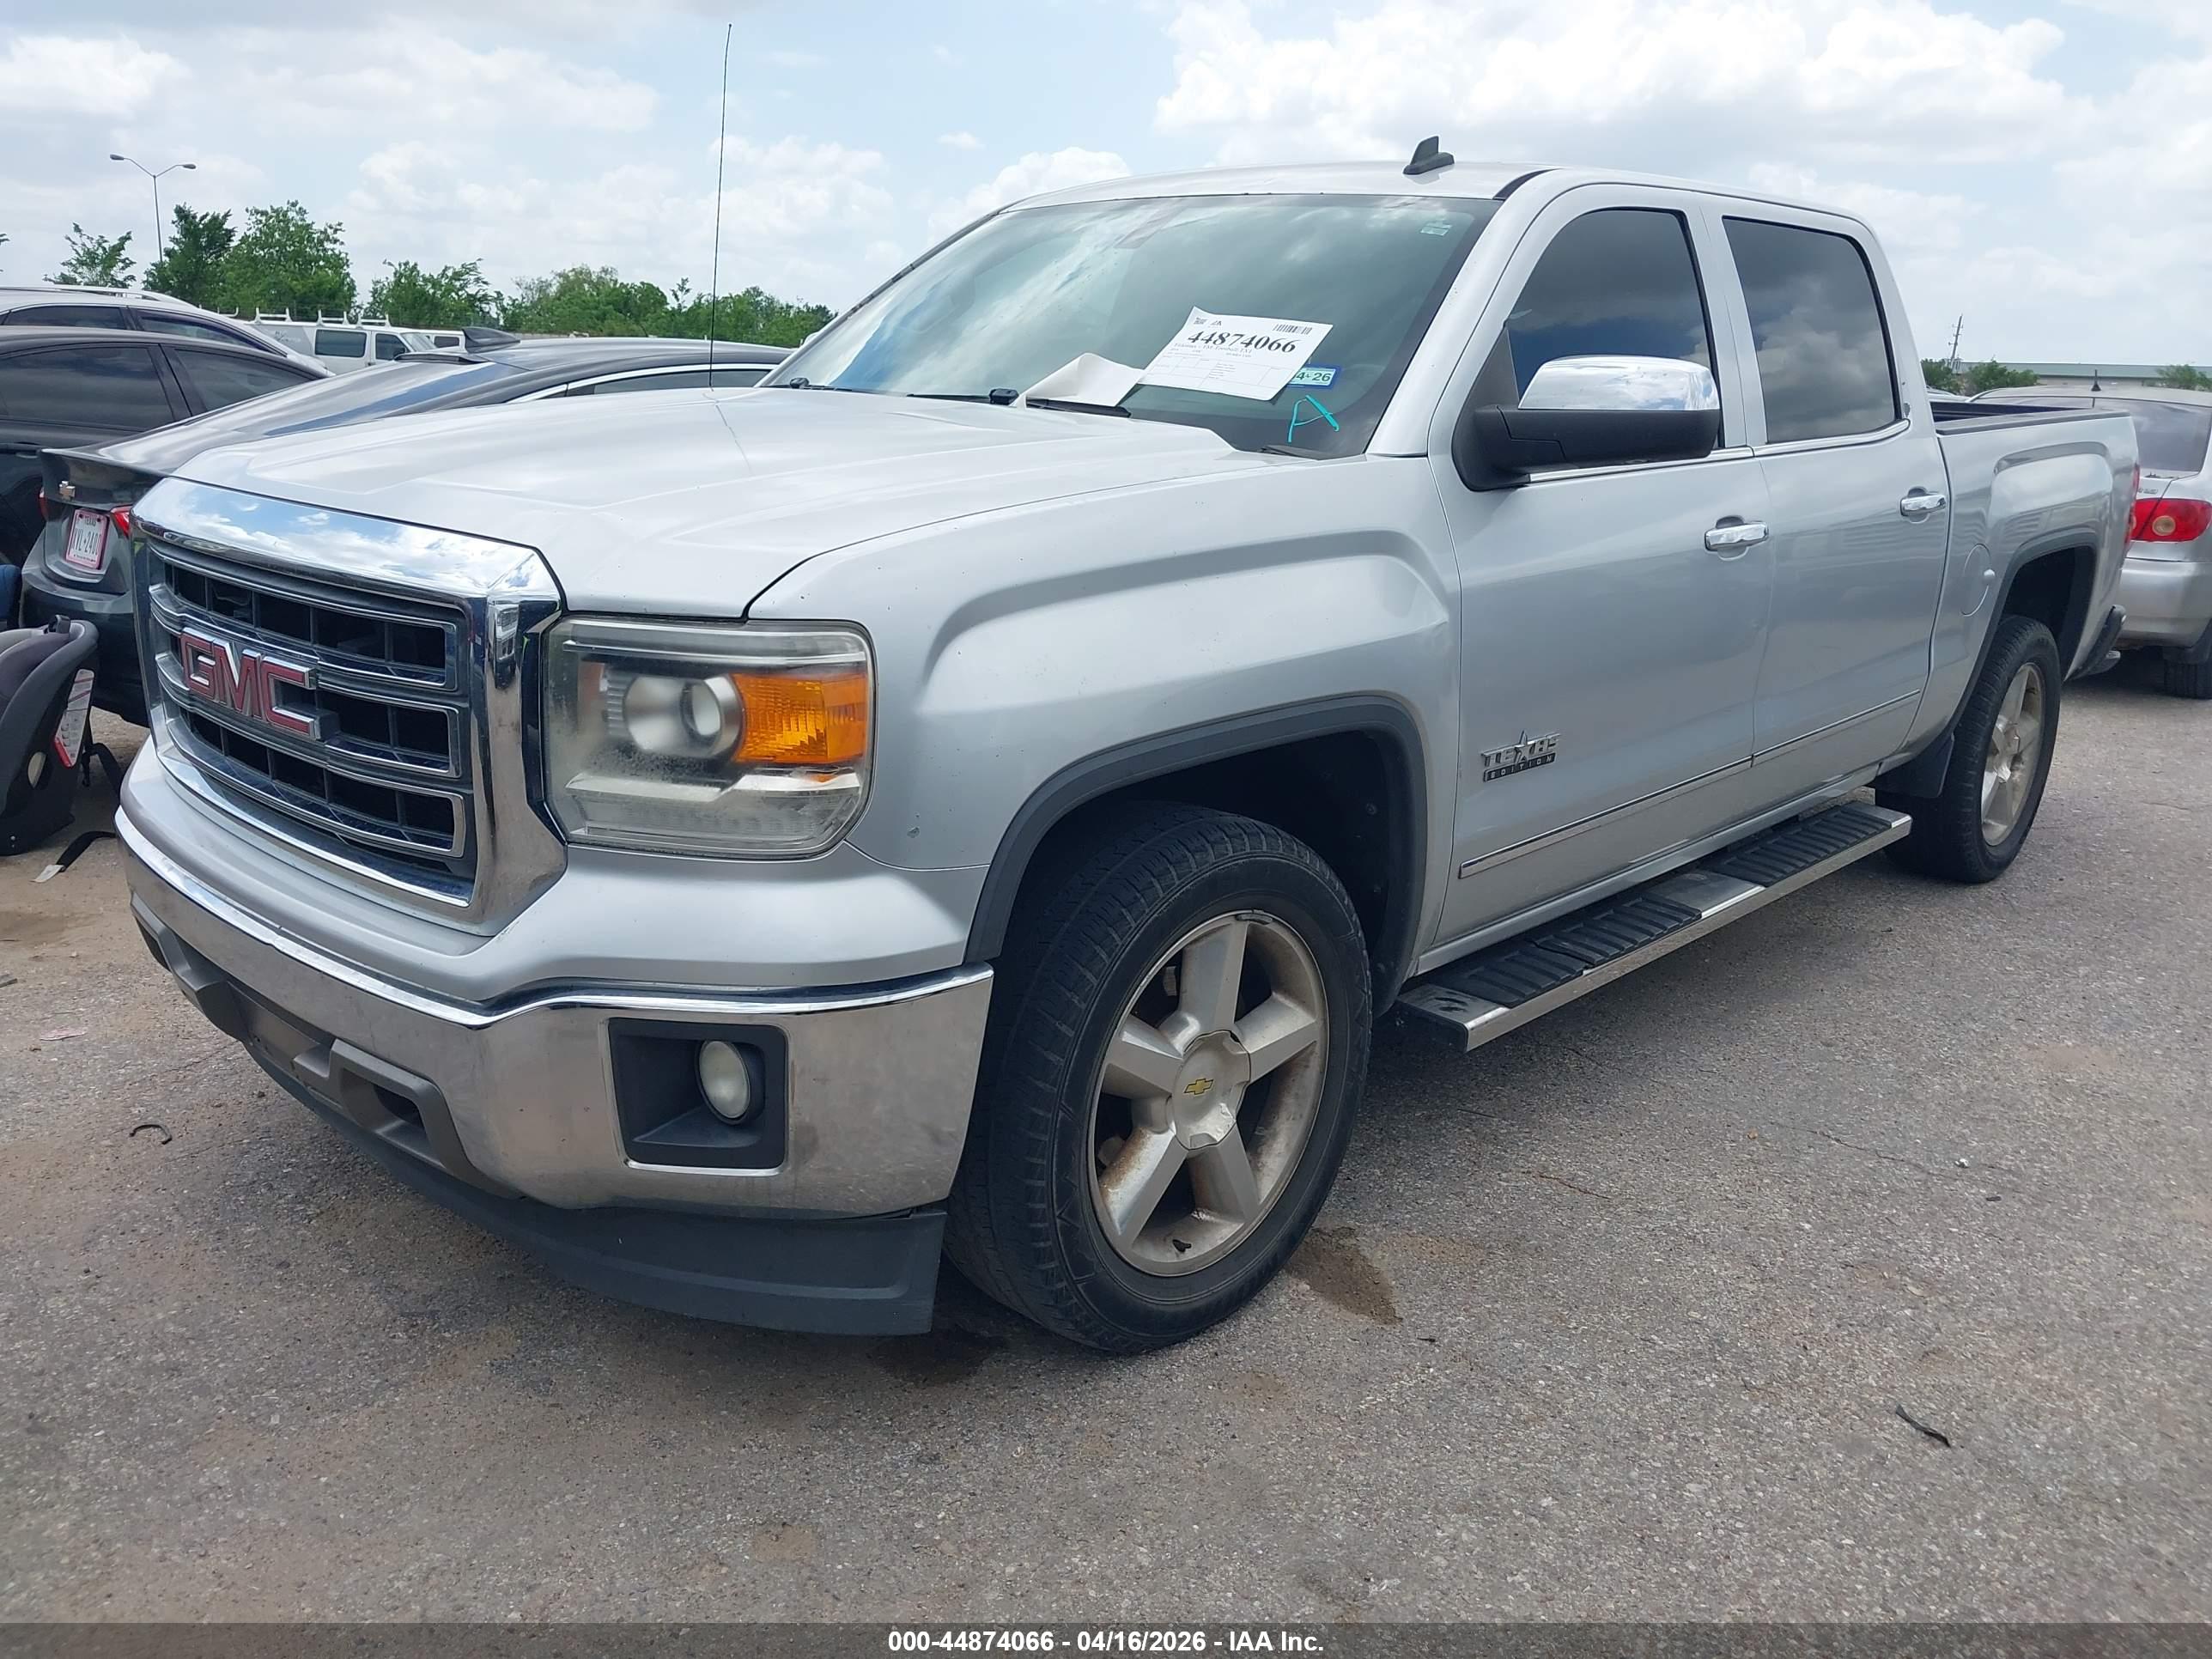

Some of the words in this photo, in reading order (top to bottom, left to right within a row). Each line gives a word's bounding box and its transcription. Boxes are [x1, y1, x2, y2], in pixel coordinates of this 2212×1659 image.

[1188, 331, 1302, 353] 44874066
[1311, 372, 1332, 382] 26
[1287, 394, 1340, 443] A
[85, 515, 97, 526] TEXAS
[179, 626, 319, 742] GMC
[1480, 730, 1561, 767] TEXAS
[1489, 755, 1553, 780] EDITION
